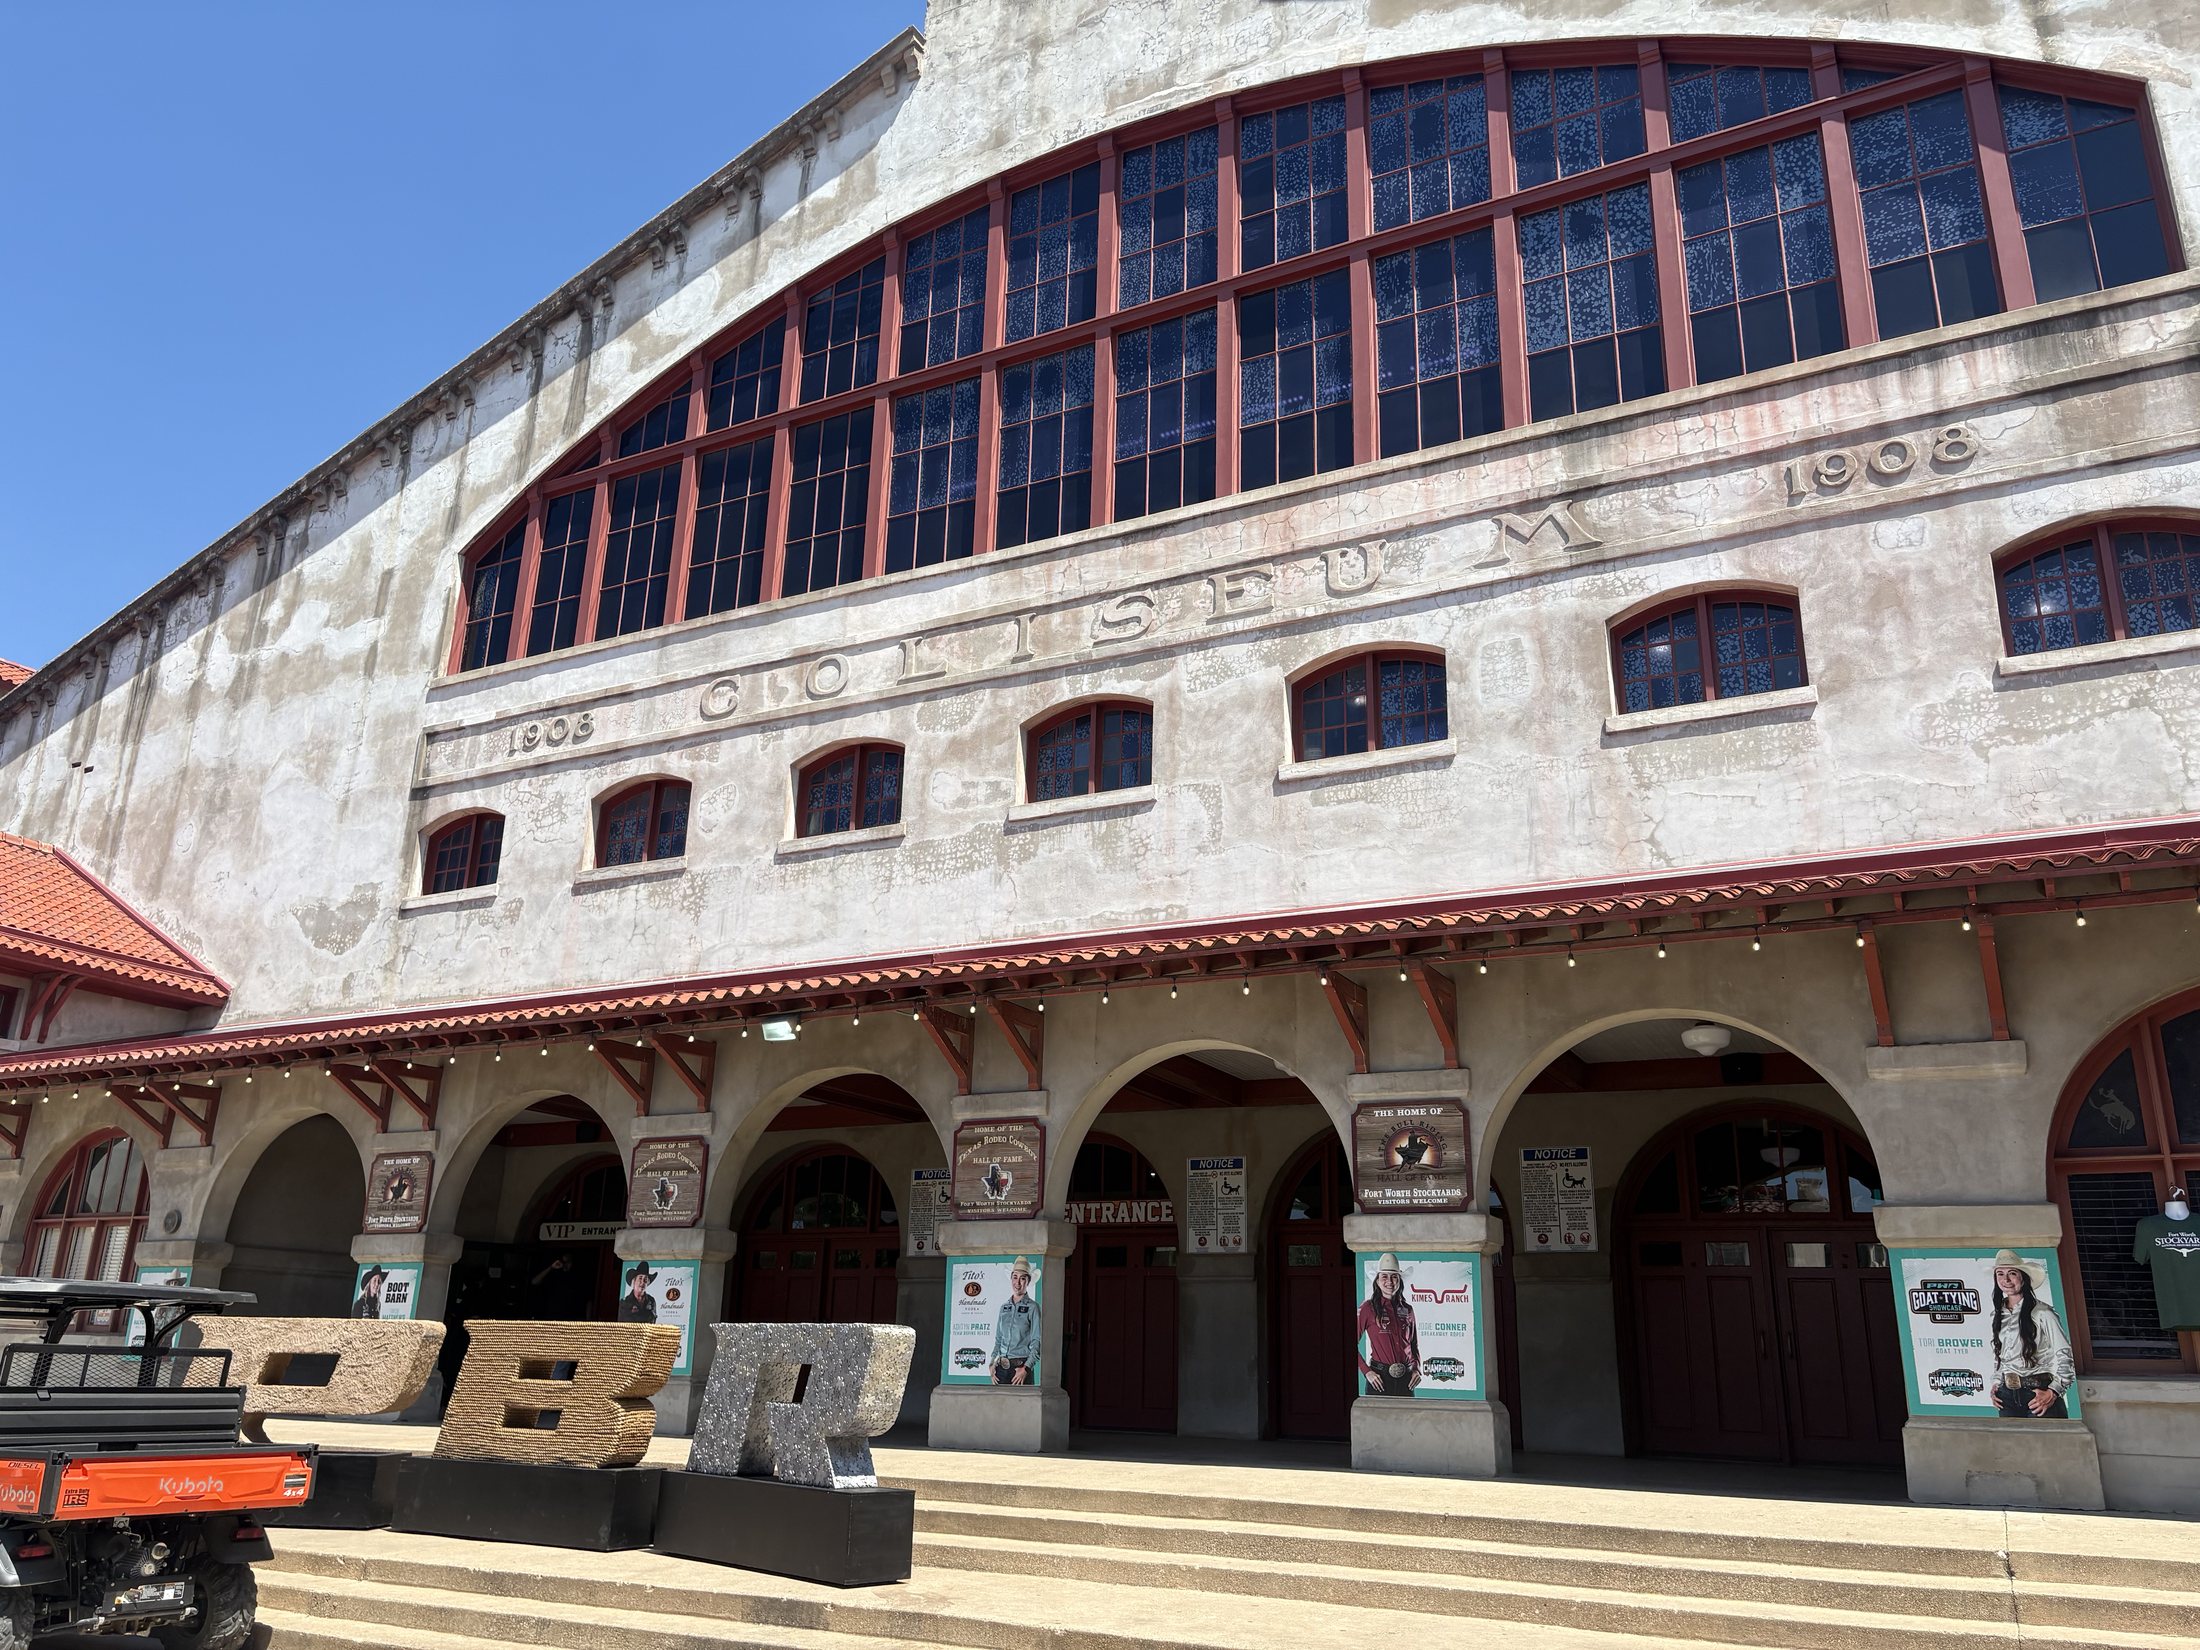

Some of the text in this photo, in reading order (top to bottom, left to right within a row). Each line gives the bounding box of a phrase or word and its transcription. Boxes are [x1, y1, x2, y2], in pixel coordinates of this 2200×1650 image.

[507, 422, 1980, 758] 1908 COLISEUM 1908
[1374, 1107, 1444, 1117] THE HOME OF
[1391, 1120, 1415, 1132] BULL
[1419, 1120, 1448, 1151] RIDING
[958, 1135, 1037, 1166] TEXAS RODEO COWBOY
[1534, 1148, 1576, 1159] NOTICE
[635, 1152, 700, 1178] TEXAS RODEO COWBOY
[1200, 1159, 1234, 1169] NOTICE
[921, 1170, 951, 1179] NOTICE
[1377, 1173, 1448, 1182] HALL OF FAME
[1364, 1188, 1461, 1198] FORT WORTH STOCKYARDS
[546, 1224, 626, 1238] VIP ENTRAN
[962, 1271, 985, 1280] Tito's
[387, 1282, 410, 1292] BOOT
[665, 1277, 684, 1287] Tito's
[385, 1293, 408, 1303] BARN
[958, 1298, 987, 1306] Handmade
[1411, 1294, 1469, 1303] KIMES RANCH
[1912, 1292, 1978, 1311] GOAT TYING
[970, 1323, 990, 1331] PRATZ
[1435, 1323, 1467, 1331] CONNER
[1919, 1338, 1983, 1347] TORI BROWER
[1423, 1363, 1464, 1373] CHAMPIONSHIP
[1930, 1376, 1983, 1387] CHAMPIONSHIP
[159, 1475, 224, 1494] Kubota
[283, 1488, 304, 1497] 4x4
[64, 1495, 88, 1504] IRS
